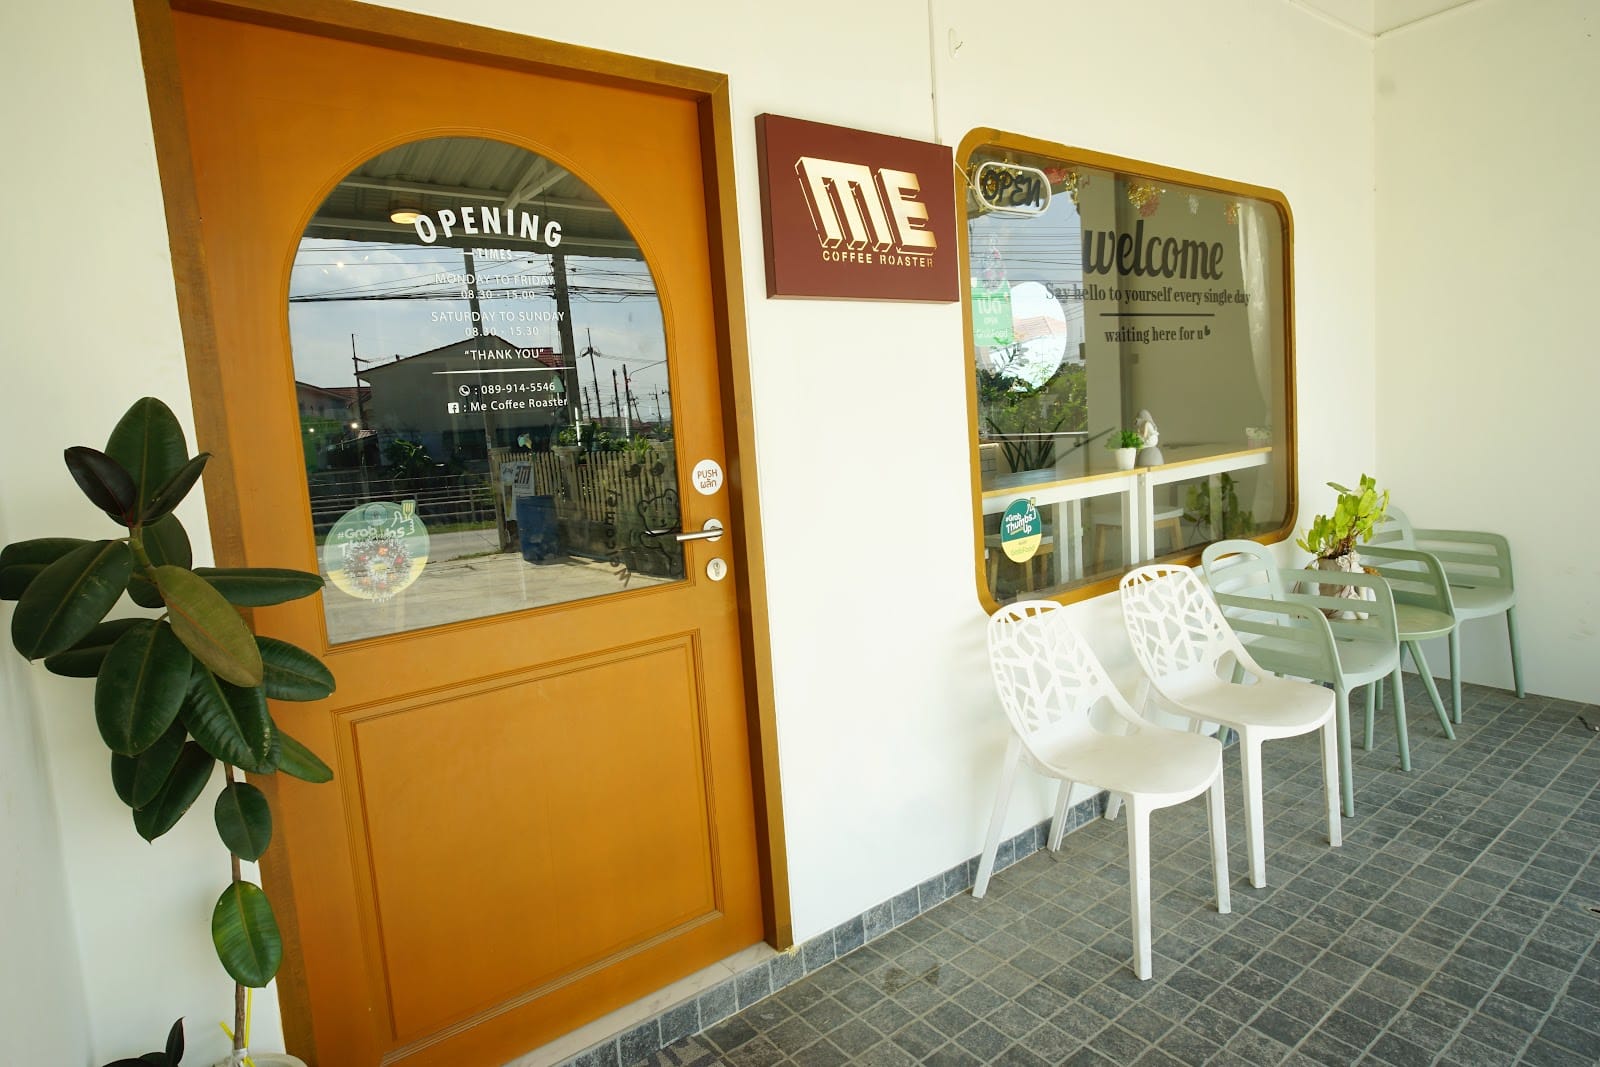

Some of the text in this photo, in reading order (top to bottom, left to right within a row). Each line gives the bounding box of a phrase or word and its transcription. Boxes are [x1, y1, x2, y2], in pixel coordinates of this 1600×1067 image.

[983, 169, 1041, 207] OPEN
[795, 156, 937, 255] ME
[414, 206, 562, 248] OPENING
[475, 248, 513, 260] TIMES
[1082, 219, 1223, 280] welcome
[822, 250, 934, 268] COFFEE ROASTER
[435, 273, 556, 286] MONDAY TO FRIDAY
[461, 289, 493, 299] 08.30
[506, 289, 535, 299] 15.00
[1046, 282, 1251, 307] Say hello to yourself every single day
[431, 311, 565, 322] SATURDAY TO SUNDAY
[465, 327, 497, 337] 08.30
[510, 326, 539, 336] 15.30
[1104, 326, 1204, 344] waiting here for u
[481, 382, 556, 395] 089-914-5546
[470, 402, 488, 412] Me
[491, 399, 526, 411] Coffee
[529, 397, 568, 408] Roaster
[697, 469, 718, 479] PUSH
[700, 477, 717, 488] ผลัก
[1006, 514, 1033, 534] Thumbs
[1023, 525, 1032, 534] Up
